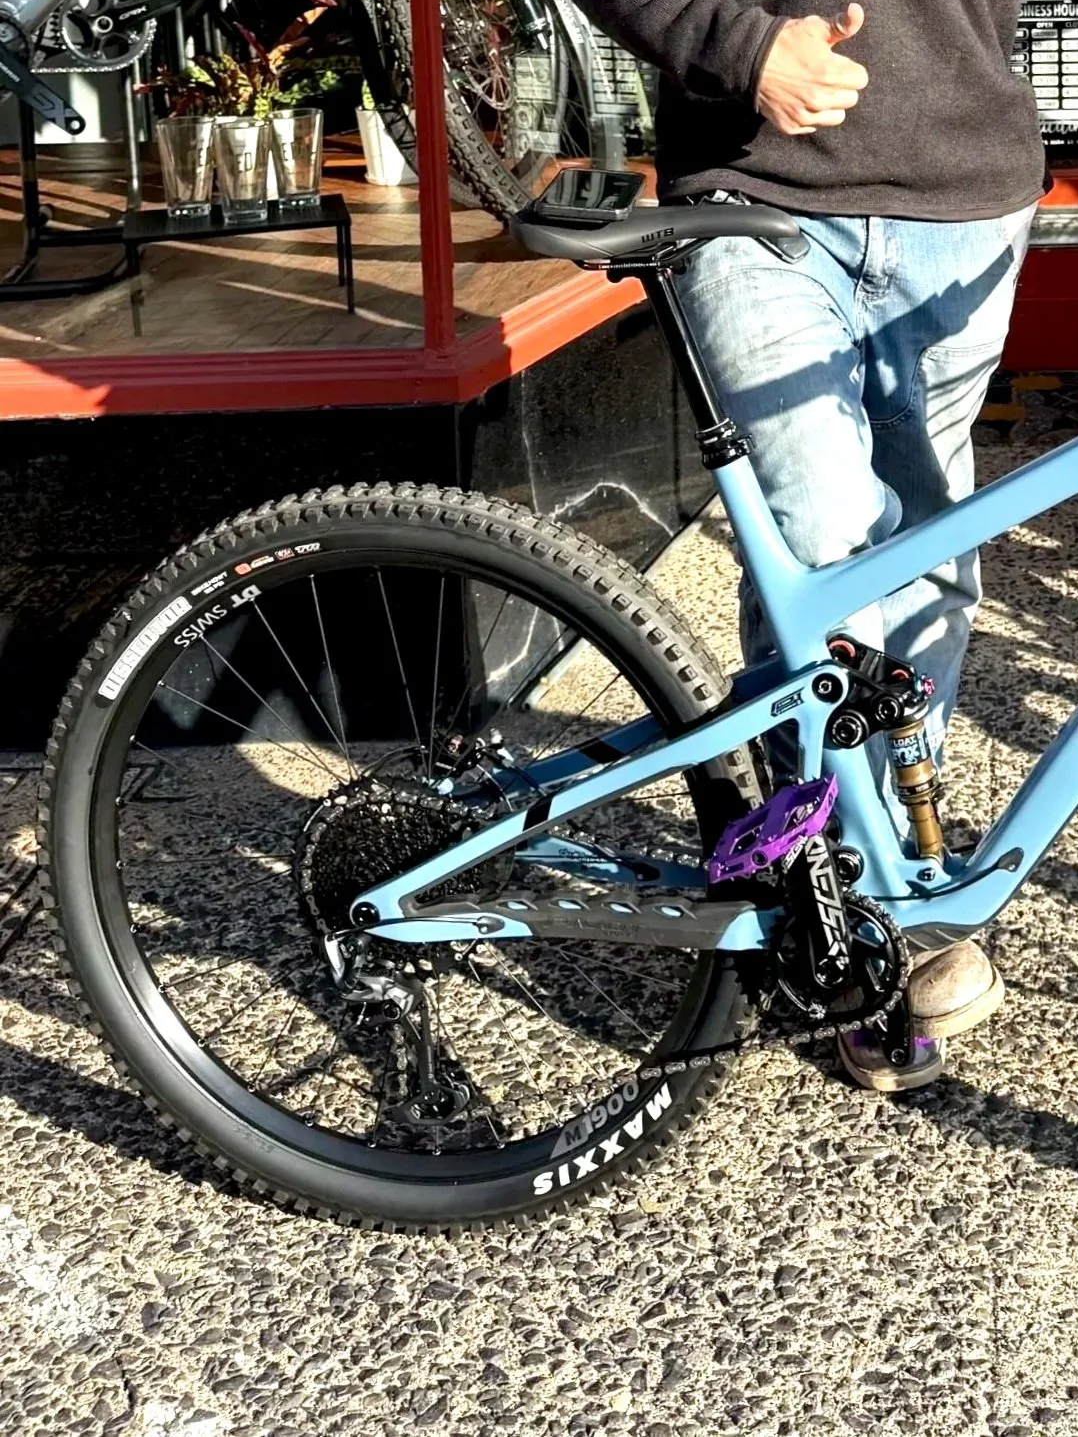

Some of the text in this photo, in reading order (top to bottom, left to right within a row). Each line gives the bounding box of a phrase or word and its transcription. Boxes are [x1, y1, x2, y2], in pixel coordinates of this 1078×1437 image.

[1018, 3, 1052, 17] SINESS
[641, 226, 674, 244] WTB
[98, 595, 193, 702] DISSECTOR
[174, 584, 262, 649] DT SWISS
[893, 735, 917, 747] LOAT
[532, 1081, 675, 1197] MAXXIS
[564, 1081, 640, 1147] M1900
